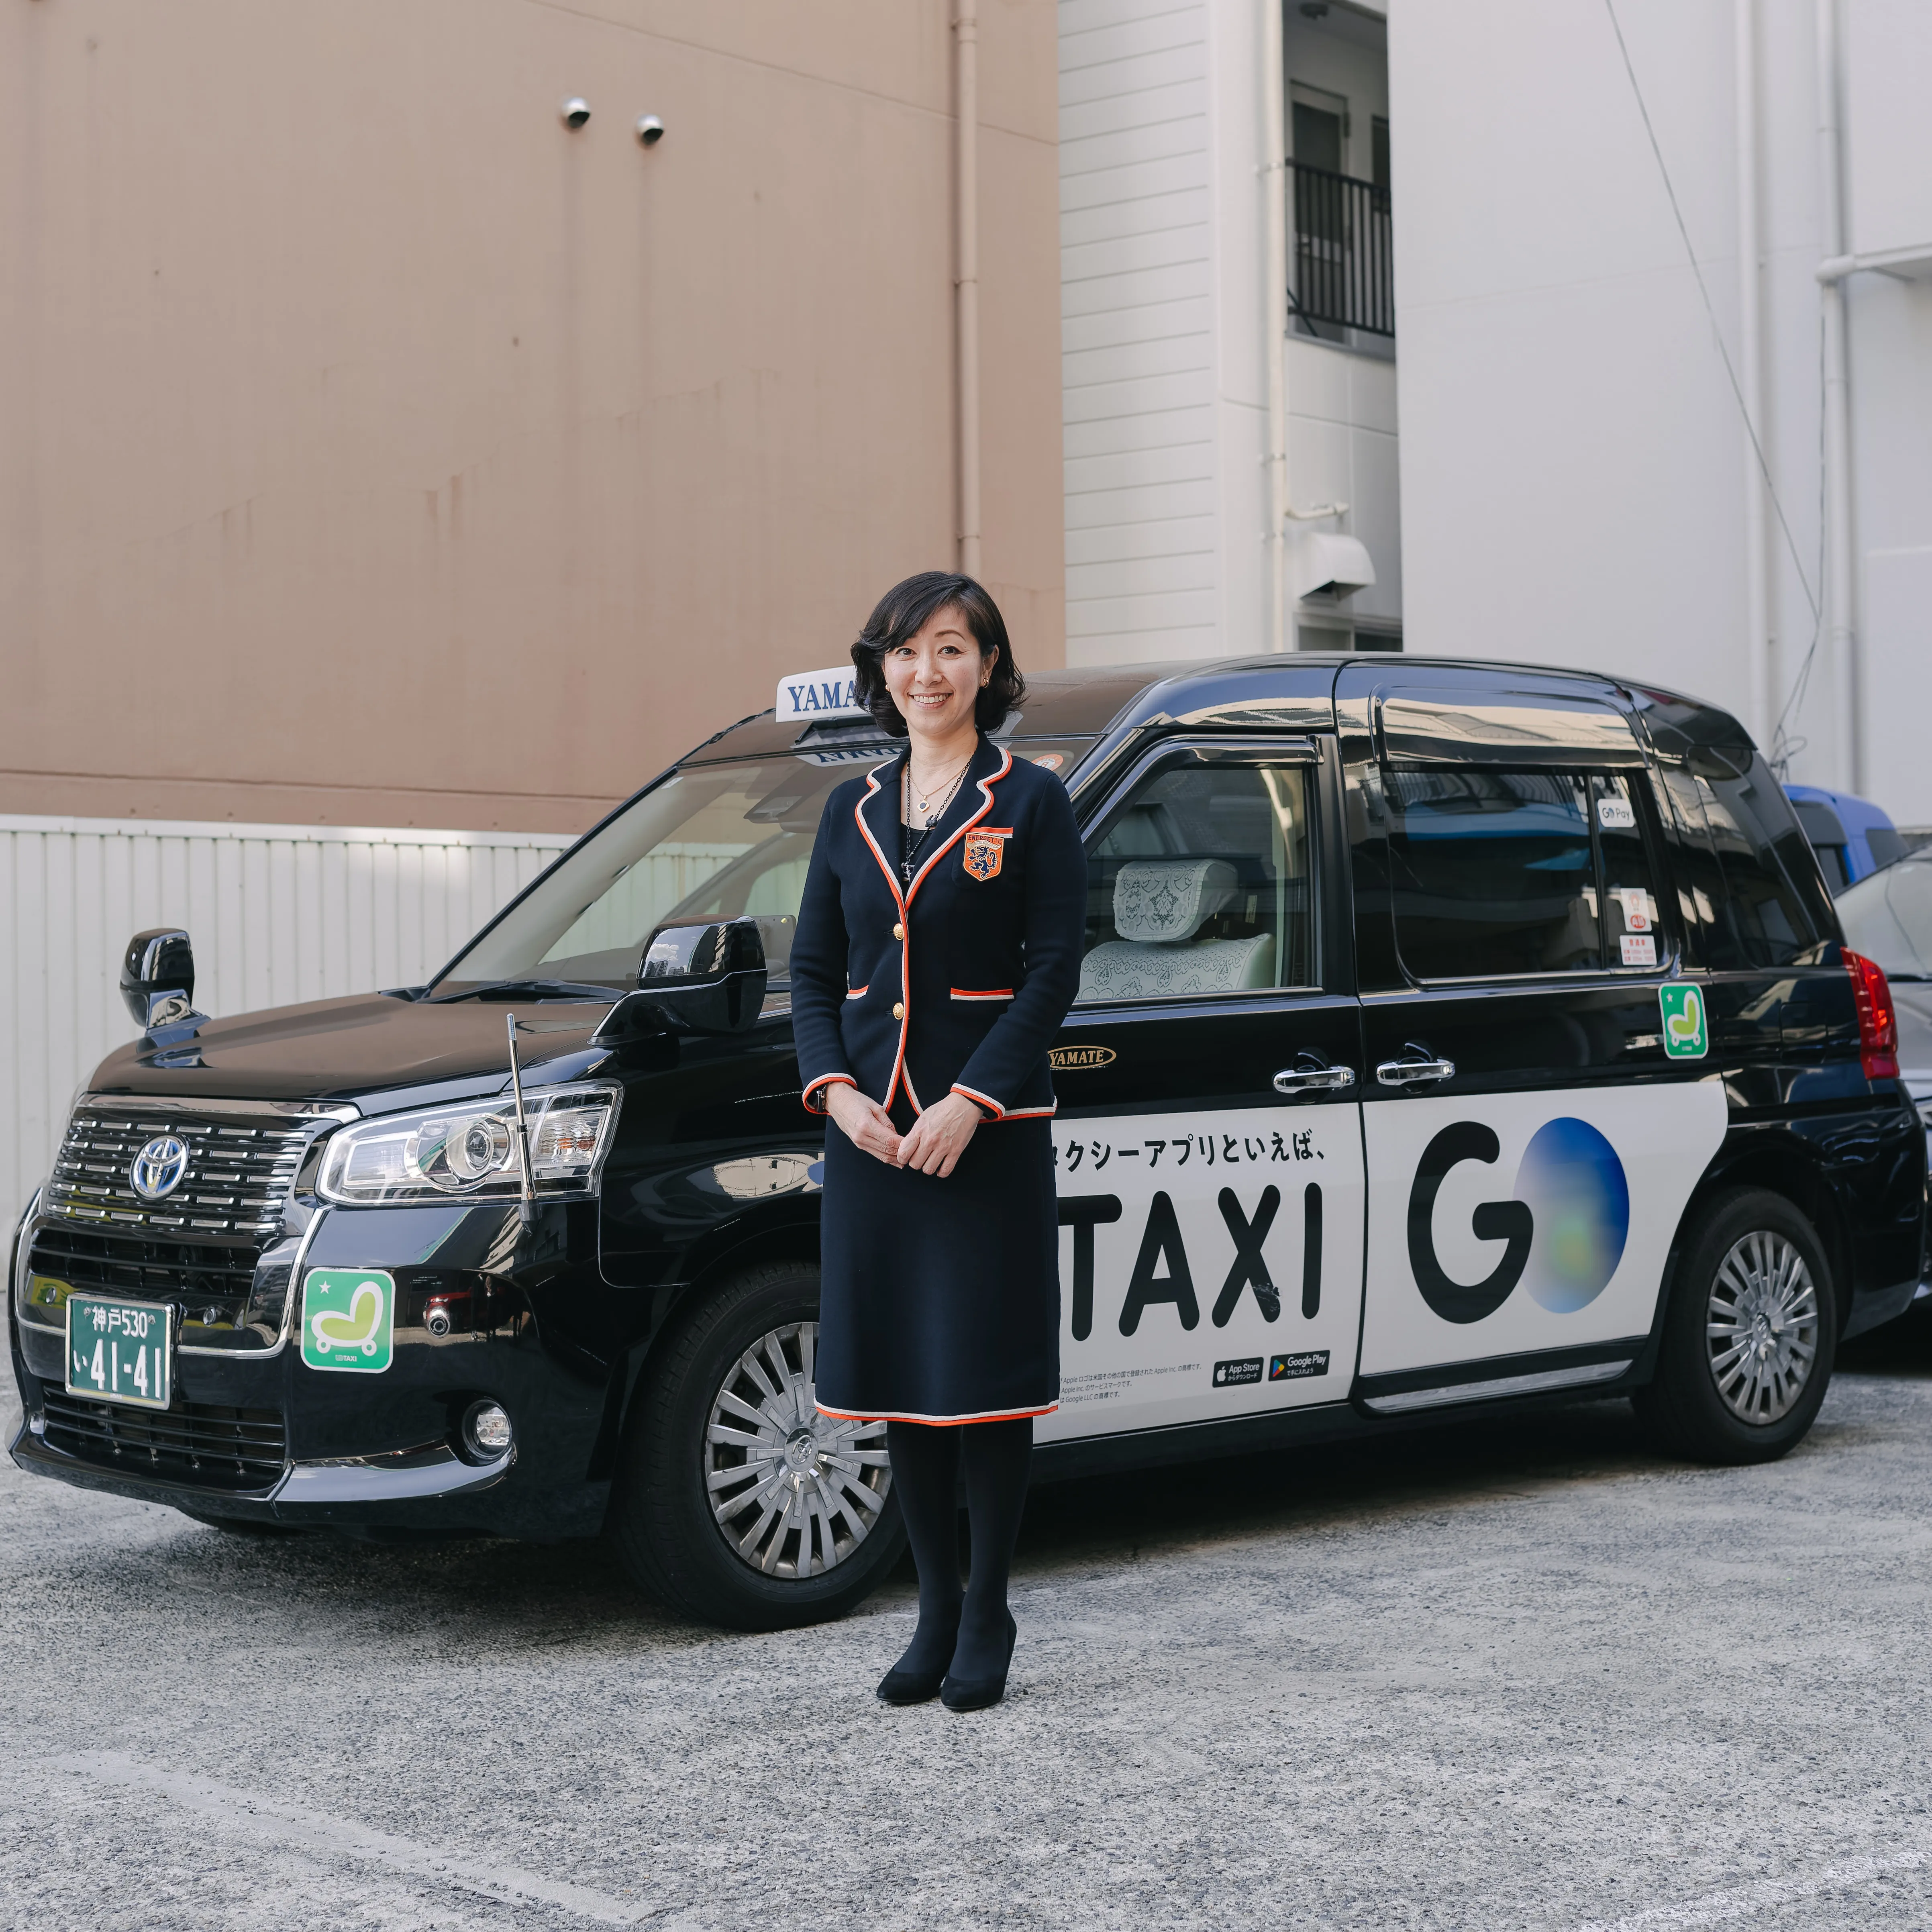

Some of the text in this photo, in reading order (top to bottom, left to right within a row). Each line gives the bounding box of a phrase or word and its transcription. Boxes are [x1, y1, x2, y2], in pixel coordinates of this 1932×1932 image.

[787, 680, 858, 712] YAMA
[1616, 808, 1629, 820] Pay
[968, 835, 1002, 844] ENERGETIC
[1049, 1050, 1104, 1065] YAMATE
[1057, 1182, 1322, 1341] TAXI
[1287, 1354, 1326, 1367] Google Play
[90, 1339, 161, 1398] 41-41
[1228, 1363, 1260, 1375] App Store
[1228, 1373, 1258, 1381] からダウンロード
